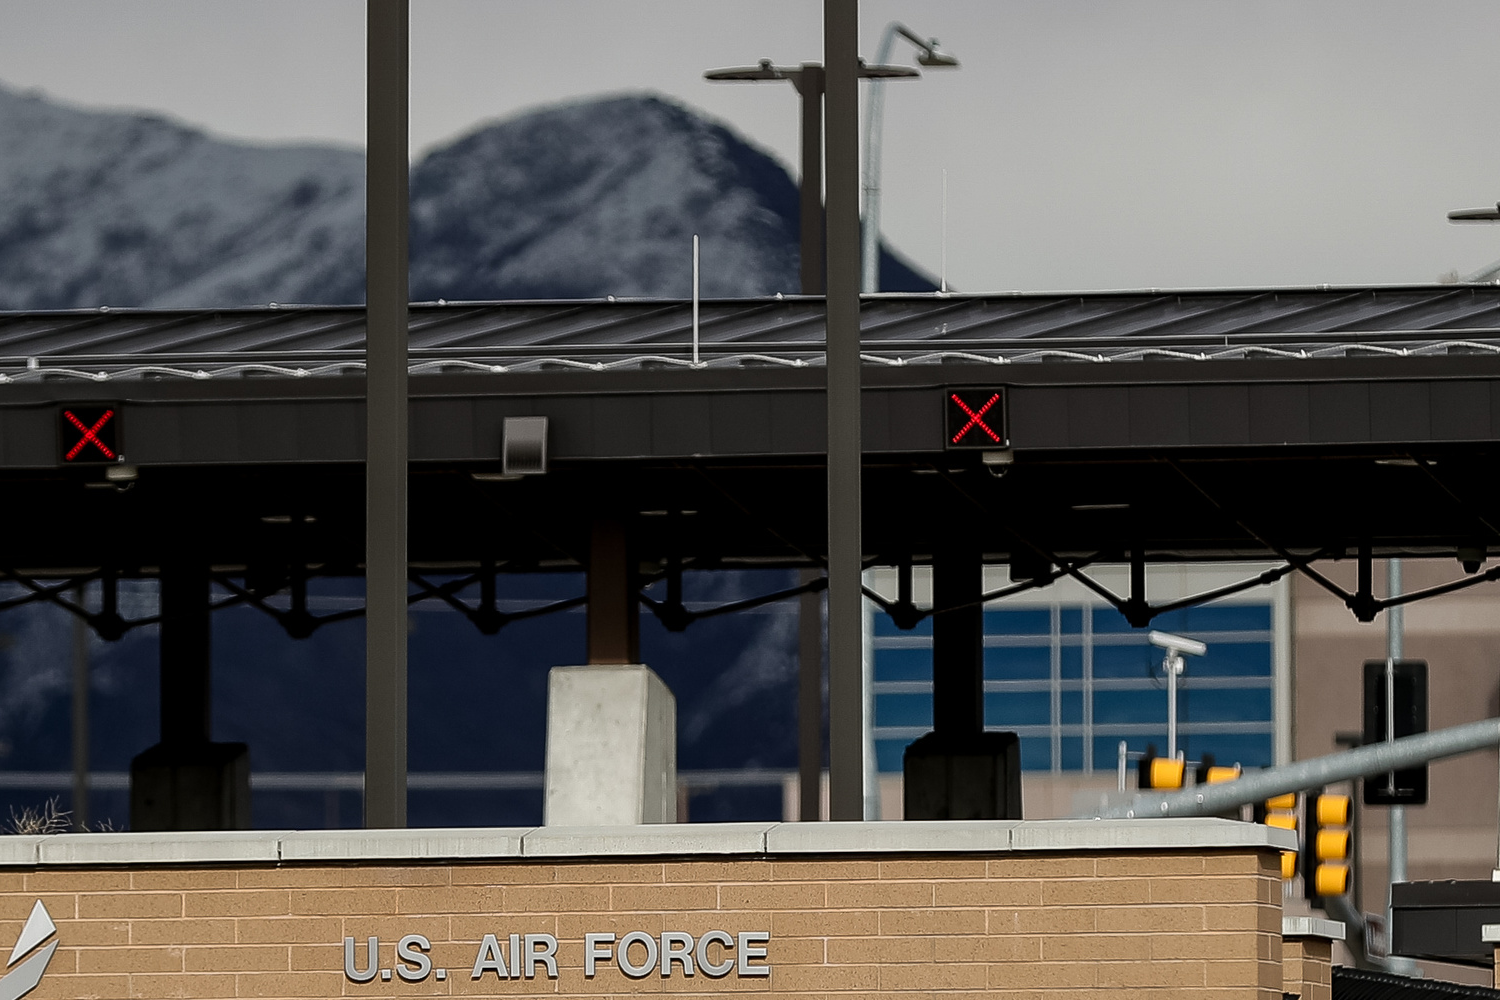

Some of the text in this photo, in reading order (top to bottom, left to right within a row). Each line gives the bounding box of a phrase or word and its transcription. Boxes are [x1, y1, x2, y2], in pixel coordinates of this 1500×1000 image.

[343, 931, 771, 982] U.S. AIR FORCE
